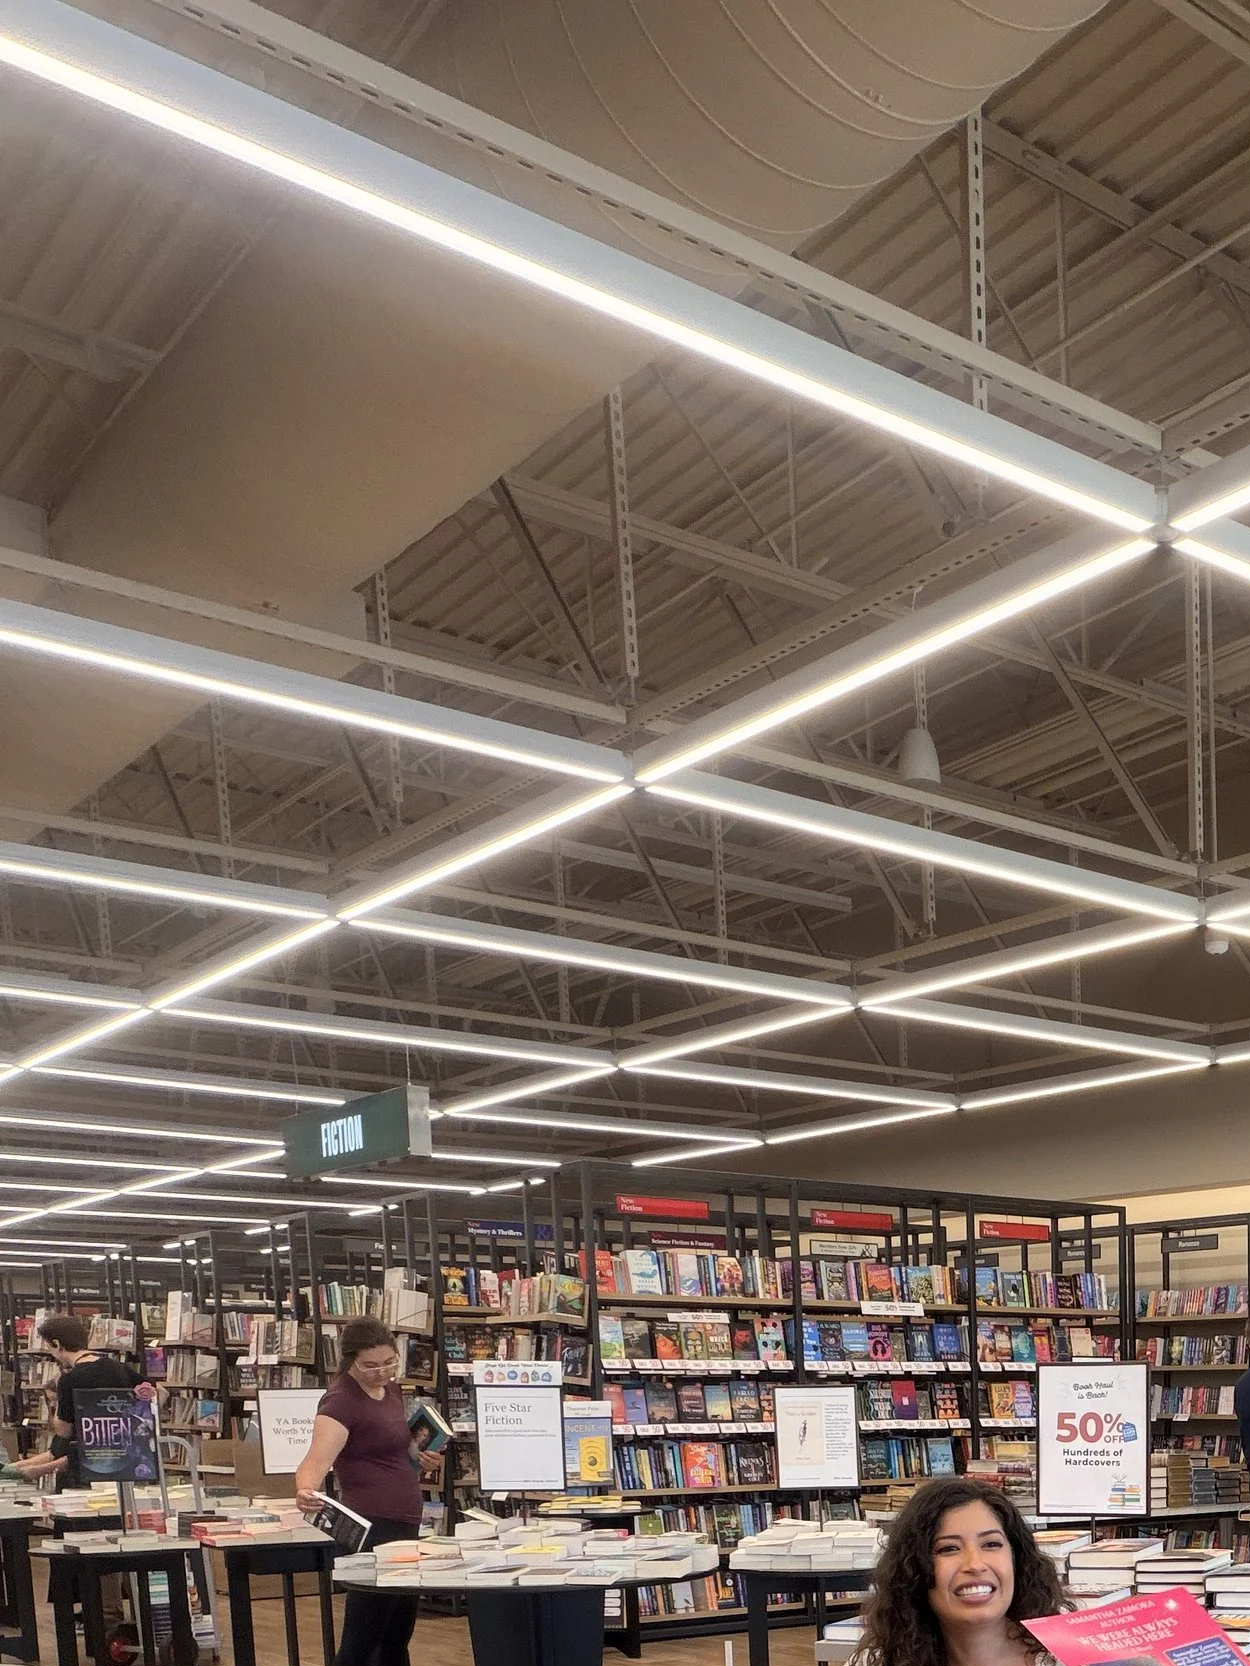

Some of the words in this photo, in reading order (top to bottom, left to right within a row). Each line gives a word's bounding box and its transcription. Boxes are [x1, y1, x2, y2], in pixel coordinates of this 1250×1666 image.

[321, 1114, 363, 1158] FICTION
[467, 1228, 490, 1236] Mystery
[497, 1228, 522, 1236] Thrillers
[695, 1240, 714, 1248] Fantasy
[1073, 1383, 1093, 1391] Book
[1095, 1381, 1113, 1390] Haul
[1086, 1391, 1109, 1399] Back!
[484, 1403, 507, 1413] Five
[510, 1403, 532, 1413] Star
[485, 1415, 522, 1425] Fiction
[1056, 1412, 1124, 1444] 50%
[1062, 1449, 1109, 1457] Hundreds
[1113, 1449, 1123, 1457] of
[1064, 1458, 1121, 1467] Hardcovers
[1066, 1610, 1116, 1625] SAMANTHA
[1080, 1635, 1097, 1646] WE
[1099, 1629, 1132, 1640] WERE
[1132, 1617, 1178, 1636] ALWAYS
[1142, 1628, 1175, 1642] HERE
